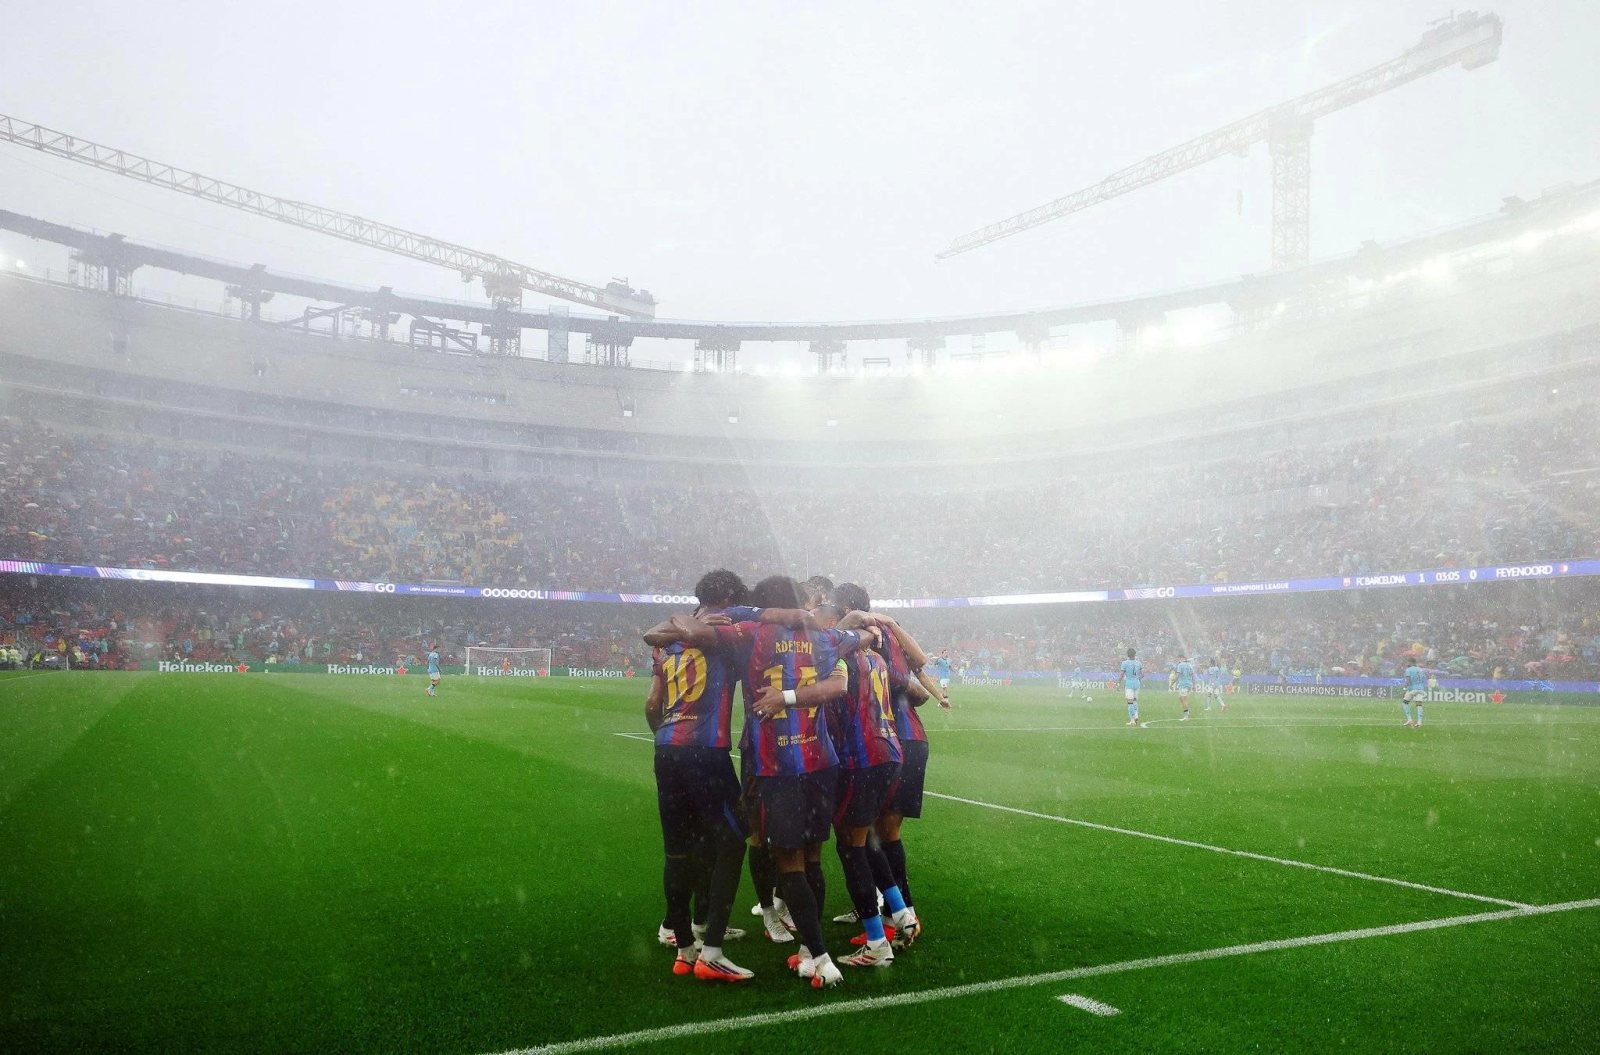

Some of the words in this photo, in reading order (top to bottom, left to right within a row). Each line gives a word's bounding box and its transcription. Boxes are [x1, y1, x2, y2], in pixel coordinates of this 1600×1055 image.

[1356, 576, 1365, 586] FC
[1366, 575, 1406, 585] BARCELONA
[1419, 574, 1425, 583] 1
[1436, 571, 1460, 581] 03:05
[1469, 570, 1477, 580] 0
[1496, 565, 1553, 578] FEYENOORD
[375, 583, 395, 593] GO
[1156, 587, 1175, 598] GO
[1212, 585, 1227, 593] UEFA
[1228, 583, 1264, 592] CHAMPIONS
[1264, 582, 1289, 590] LEAGUE
[158, 661, 233, 673] Heineken
[327, 664, 394, 675] Heineken
[568, 667, 623, 678] Heineken
[663, 648, 708, 710] 10
[1264, 685, 1284, 694] UEFA
[1286, 686, 1336, 696] CHAMPIONS
[1338, 687, 1372, 697] LEAGUE
[1421, 688, 1486, 703] eineken
